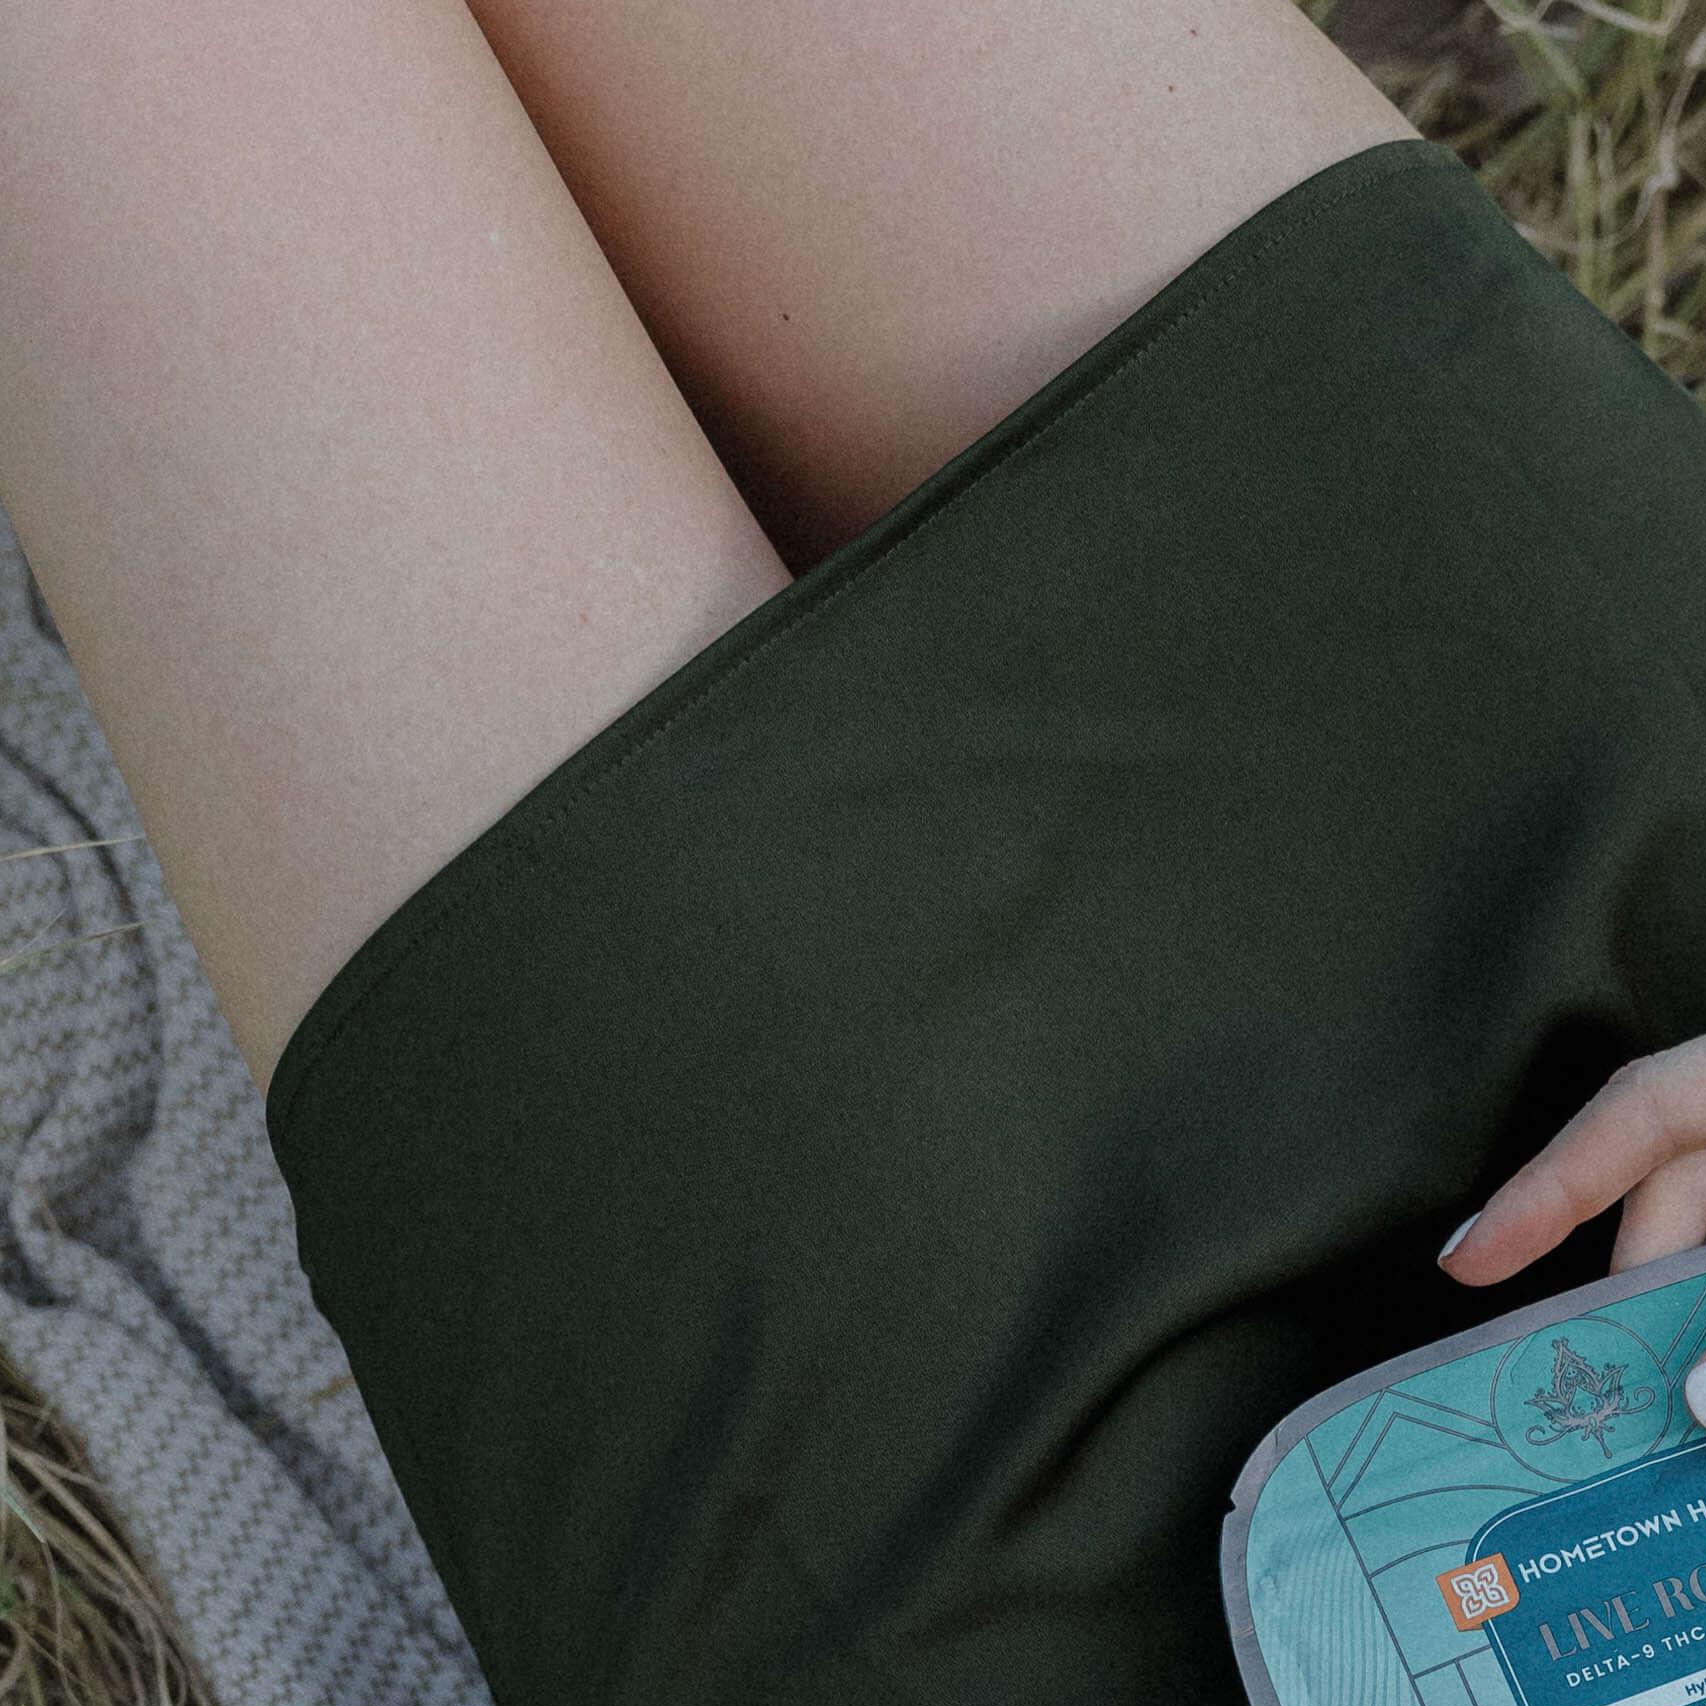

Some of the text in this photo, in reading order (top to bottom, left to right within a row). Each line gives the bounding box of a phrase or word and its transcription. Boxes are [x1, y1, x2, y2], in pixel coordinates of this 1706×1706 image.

[1518, 1510, 1683, 1583] HOMETOWN
[1538, 1590, 1650, 1662] LIVE
[1566, 1644, 1655, 1688] DELTA-9
[1662, 1626, 1706, 1651] THC
